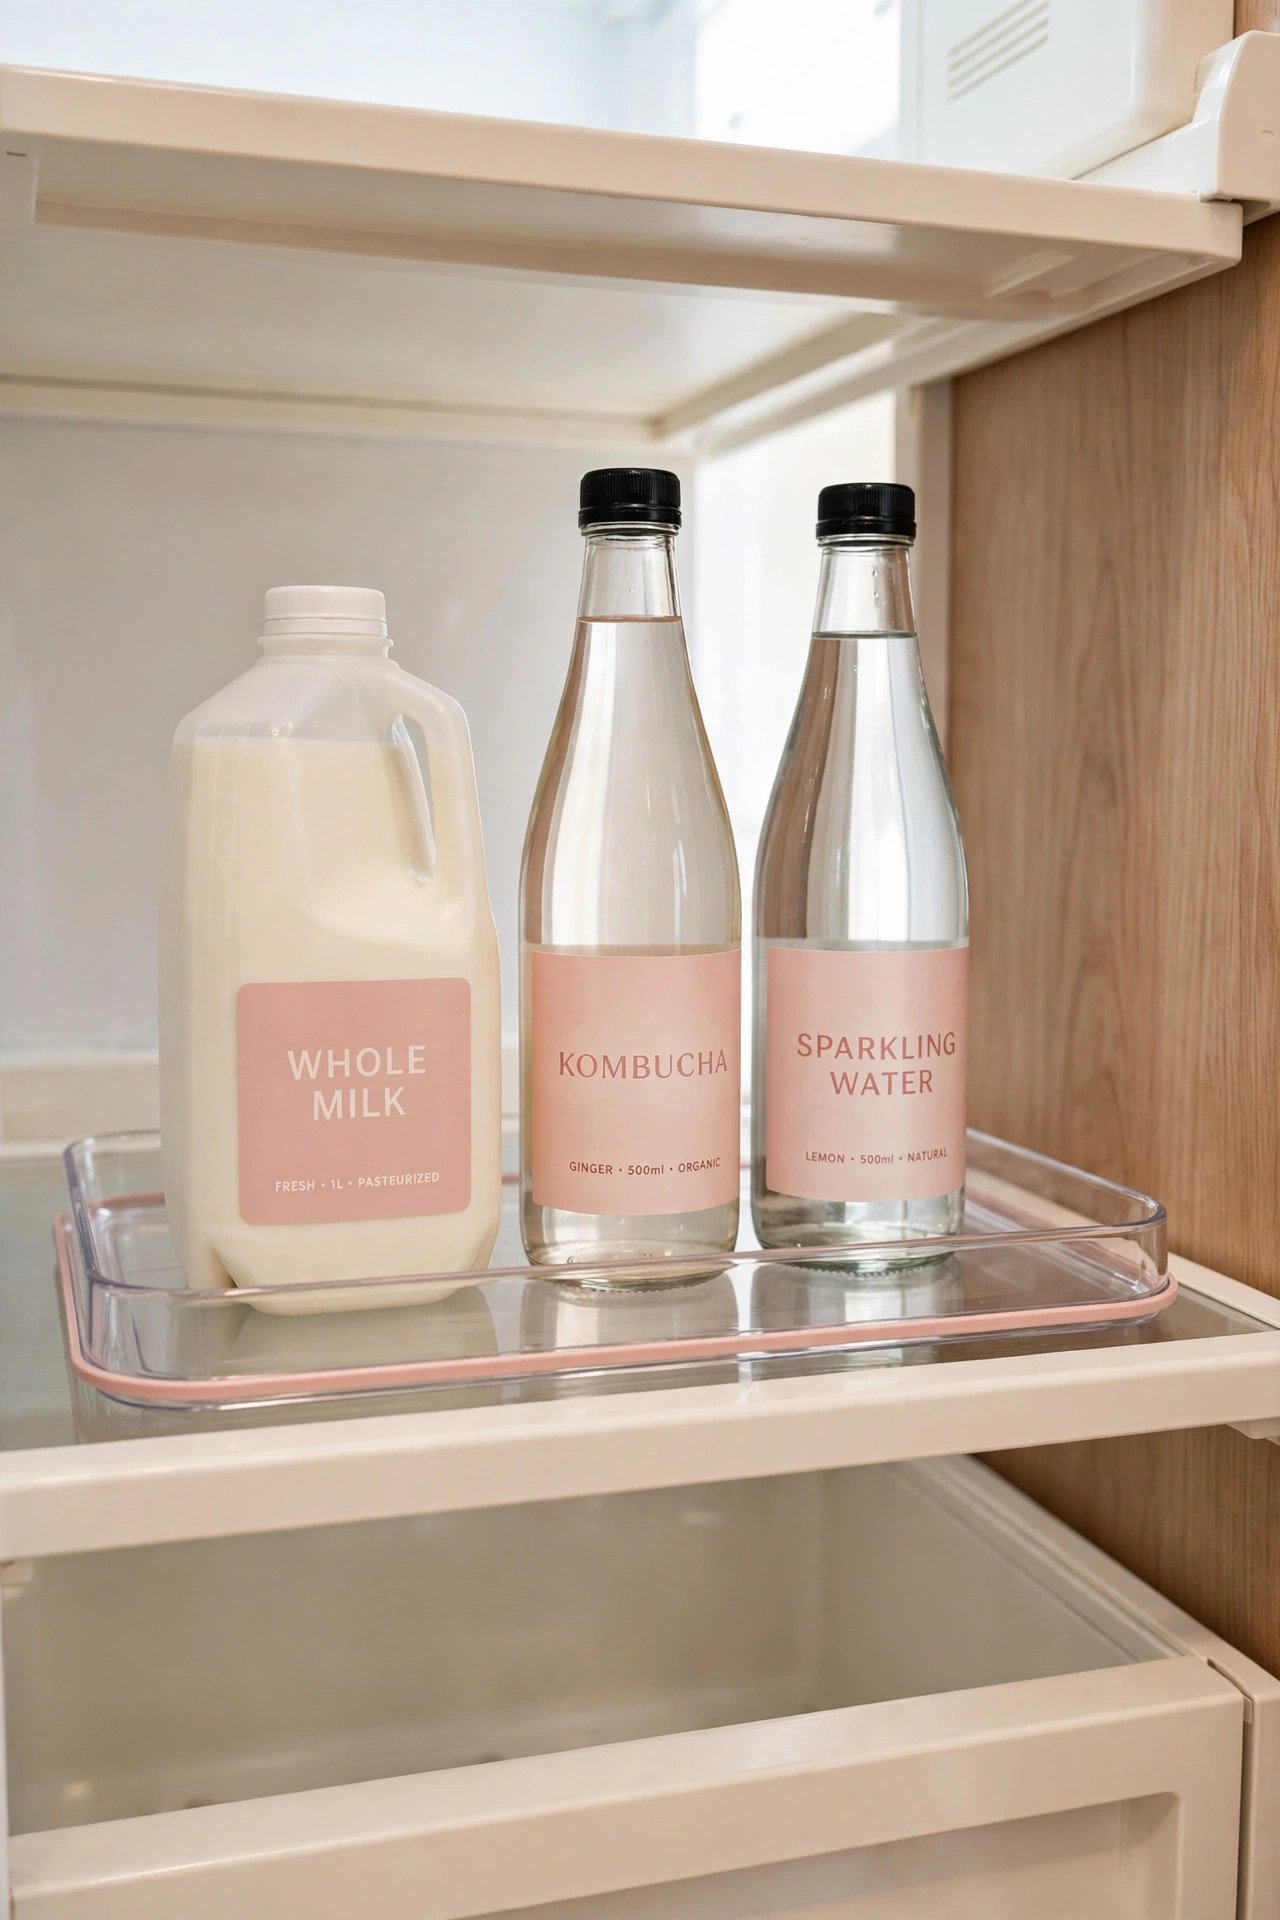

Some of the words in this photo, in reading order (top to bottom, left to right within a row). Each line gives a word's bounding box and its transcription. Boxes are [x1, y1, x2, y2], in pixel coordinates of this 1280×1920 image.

[797, 1031, 956, 1060] SPARKLING
[287, 1045, 426, 1080] WHOLE
[559, 1049, 728, 1079] KOMBUCHA
[829, 1069, 934, 1096] WATER
[313, 1086, 406, 1120] MILK
[569, 1160, 613, 1175] GINGER
[627, 1164, 664, 1175] 500ml
[677, 1156, 721, 1173] ORGANIC
[805, 1151, 845, 1163] LEMON
[859, 1153, 893, 1164] 500ml
[907, 1147, 948, 1162] NATURAL
[275, 1180, 315, 1192] FRESH
[330, 1179, 343, 1190] 1L
[358, 1171, 440, 1188] PASTEURIZED
